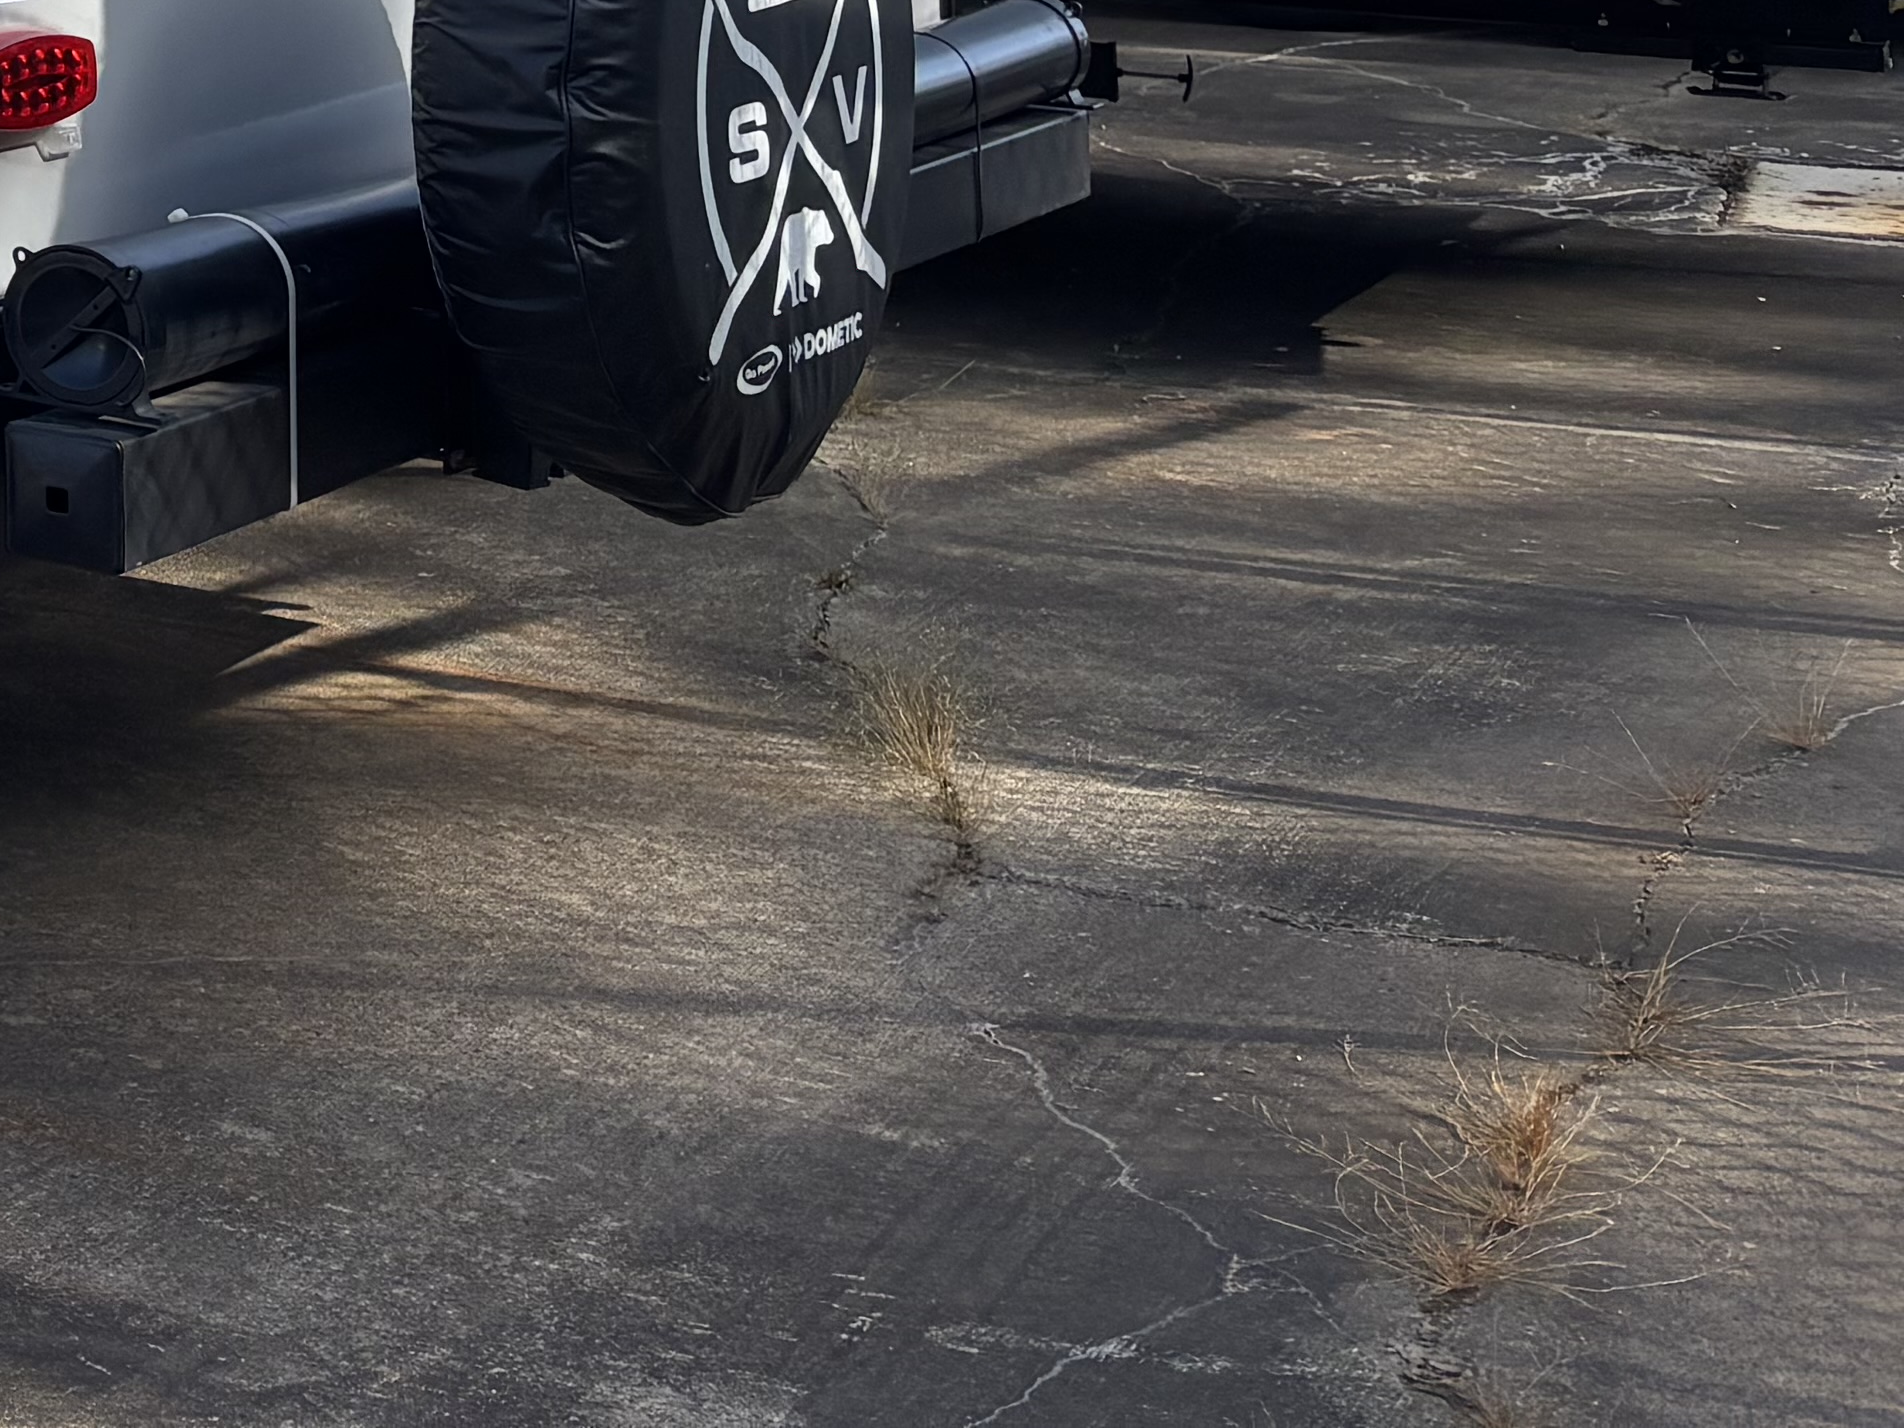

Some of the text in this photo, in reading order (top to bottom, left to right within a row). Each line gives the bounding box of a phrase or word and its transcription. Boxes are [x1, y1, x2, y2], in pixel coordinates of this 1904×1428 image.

[728, 65, 867, 184] S V
[804, 311, 863, 360] DOMETIC
